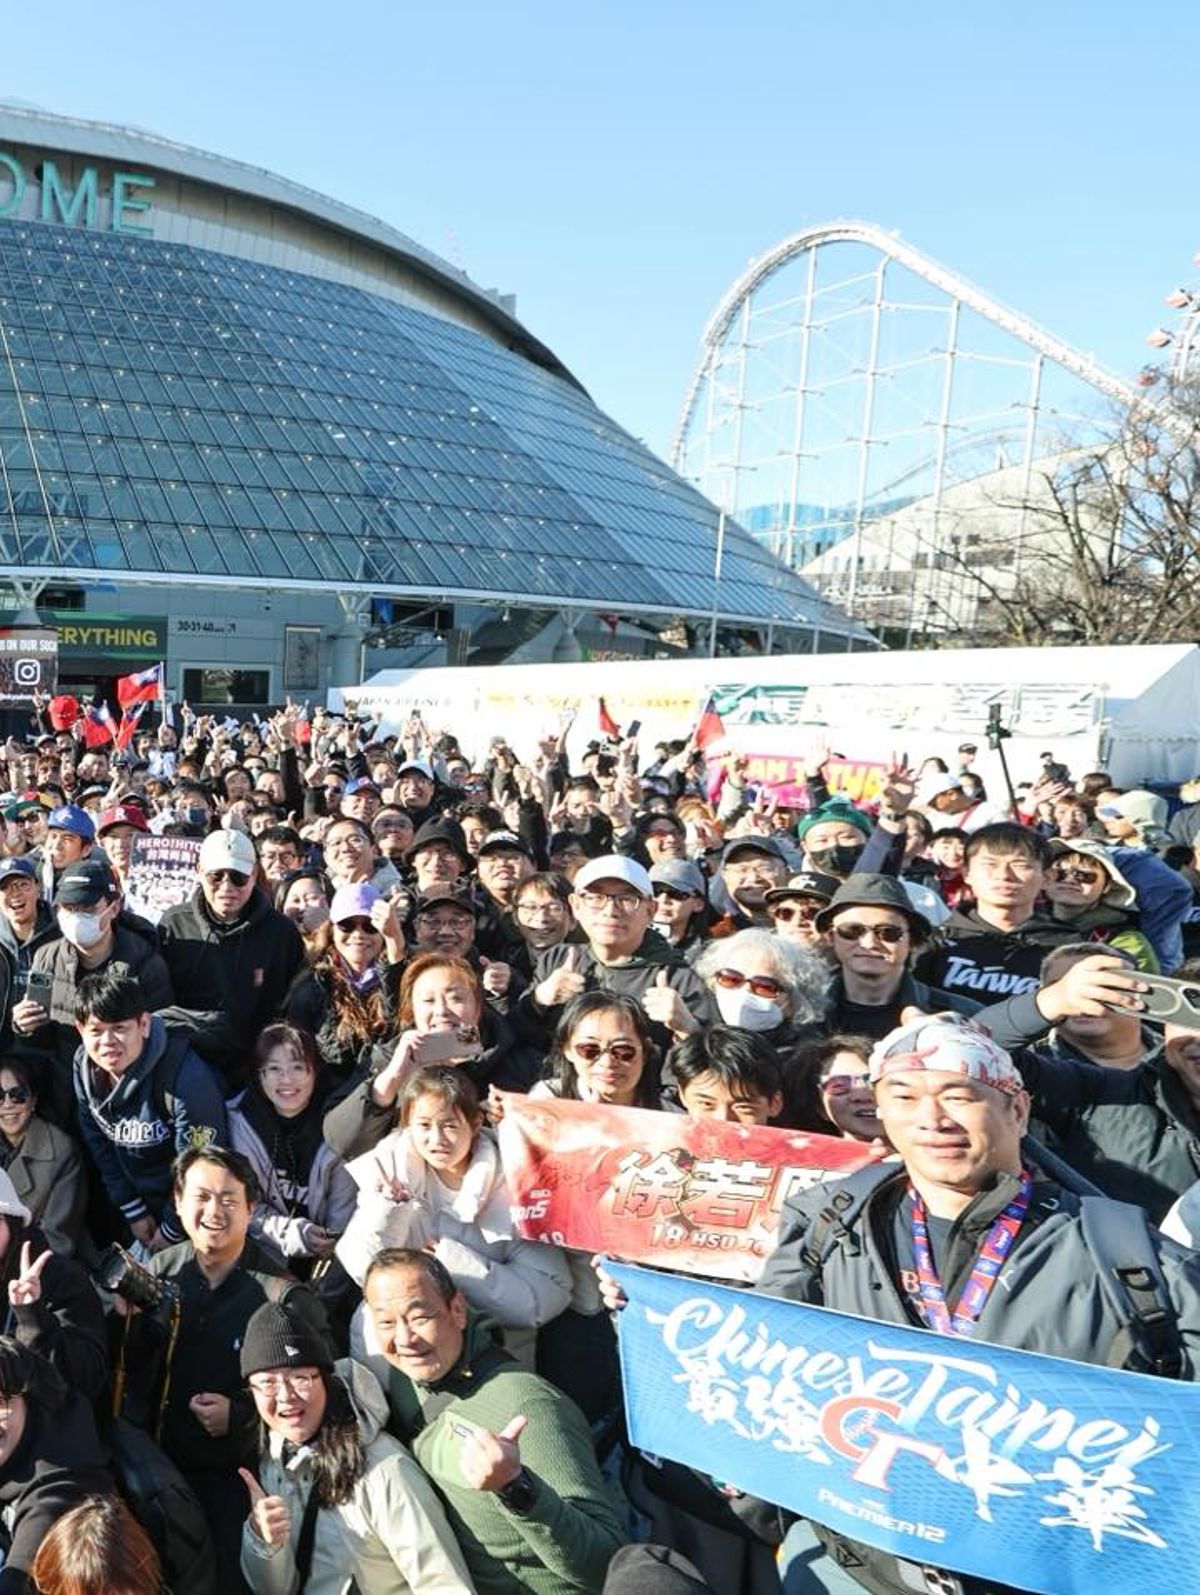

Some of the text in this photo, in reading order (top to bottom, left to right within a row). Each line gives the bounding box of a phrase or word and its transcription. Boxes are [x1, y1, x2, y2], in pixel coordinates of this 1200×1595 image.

[57, 627, 157, 647] ERYTHING
[943, 956, 1041, 995] Taiwa
[644, 1297, 1174, 1468] Chinese Taipei
